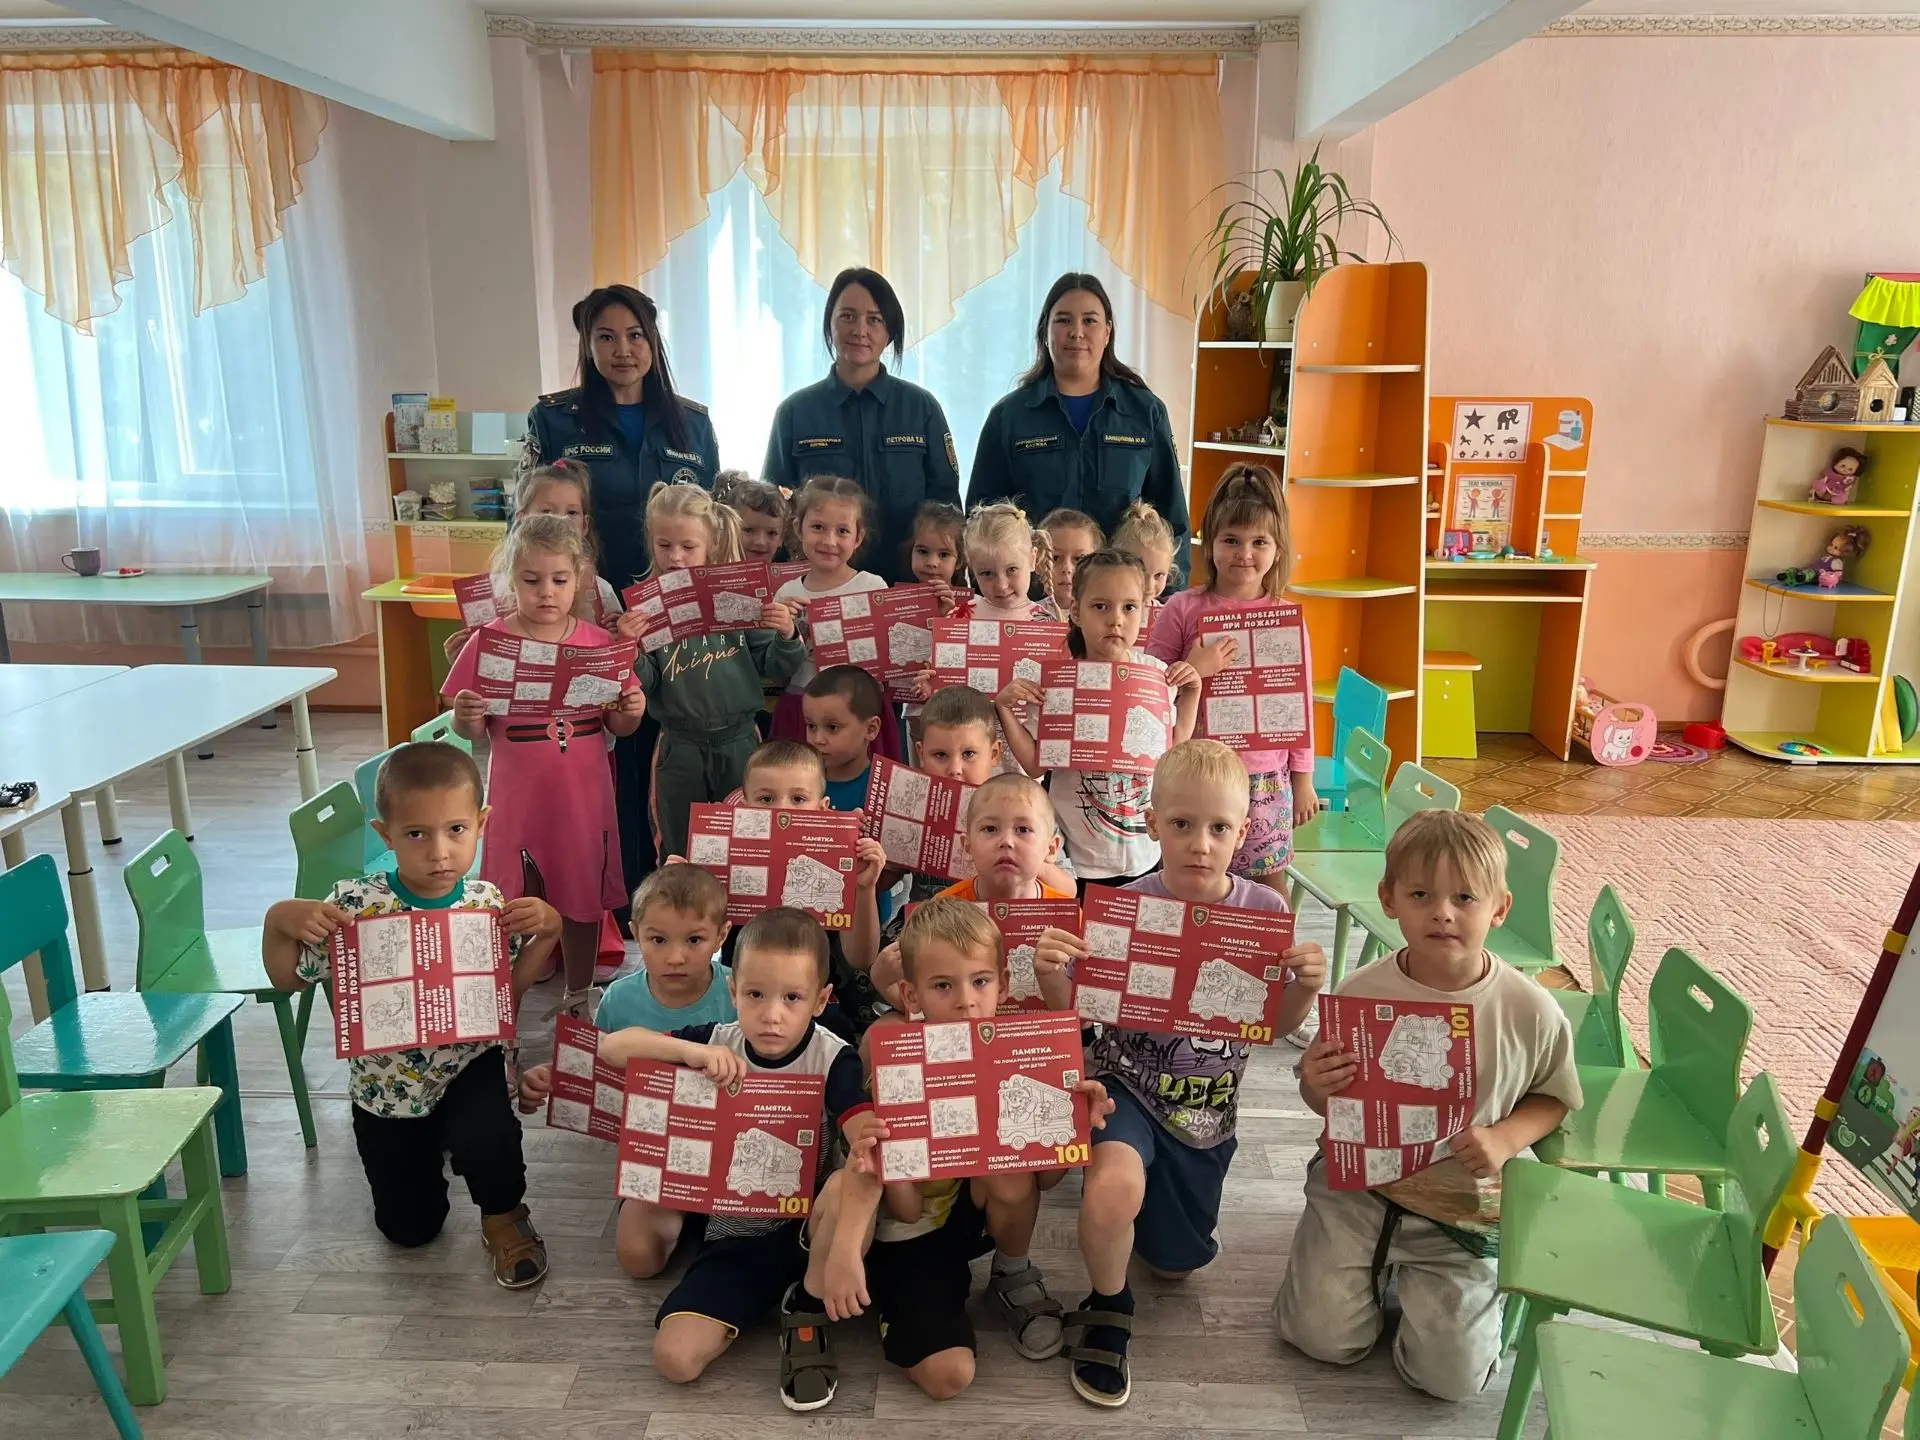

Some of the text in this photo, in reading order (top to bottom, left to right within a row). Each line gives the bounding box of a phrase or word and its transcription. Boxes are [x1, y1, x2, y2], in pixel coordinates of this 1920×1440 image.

[886, 435, 915, 444] ПЕТРОВА
[581, 445, 611, 455] РОССИИ
[1203, 609, 1298, 623] ПРАВИЛА ПОВЕДЕНИЯ
[1222, 619, 1281, 630] ПРИ ПОЖАРЕ
[868, 760, 883, 812] ПОВЕДЕНИЯ
[872, 781, 887, 838] ПРИ ПОЖАРЕ
[824, 912, 852, 928] 101
[421, 917, 430, 971] СЛЕДУЕТ СРОЧНО
[1220, 936, 1261, 948] ПАМЯТКА
[348, 947, 360, 1024] ПРИ ПОЖАРЕ
[438, 984, 446, 1006] АДРЕС
[419, 1001, 427, 1028] ПОЖАРЕ
[431, 988, 441, 1032] НАЗОВИ СВОЙ
[339, 998, 350, 1051] ПРАВИЛА
[1174, 1019, 1204, 1028] ТЕЛЕФОН
[1451, 1006, 1470, 1039] 101
[1172, 1025, 1240, 1038] ПОЖАРНОЙ ОХРАНЫ
[1239, 1023, 1272, 1042] 101
[1012, 1046, 1052, 1056] ПАМЯТКА
[754, 1104, 793, 1112] ПАМЯТКА
[987, 1154, 1020, 1163] ТЕЛЕФОН
[1054, 1143, 1089, 1164] 101
[988, 1158, 1057, 1170] ПОЖАРНОЙ ОХРАНЫ
[712, 1205, 778, 1214] ПОЖАРНОЙ ОХРАНЫ
[713, 1198, 743, 1206] ТЕЛЕФОН
[778, 1197, 810, 1214] 101
